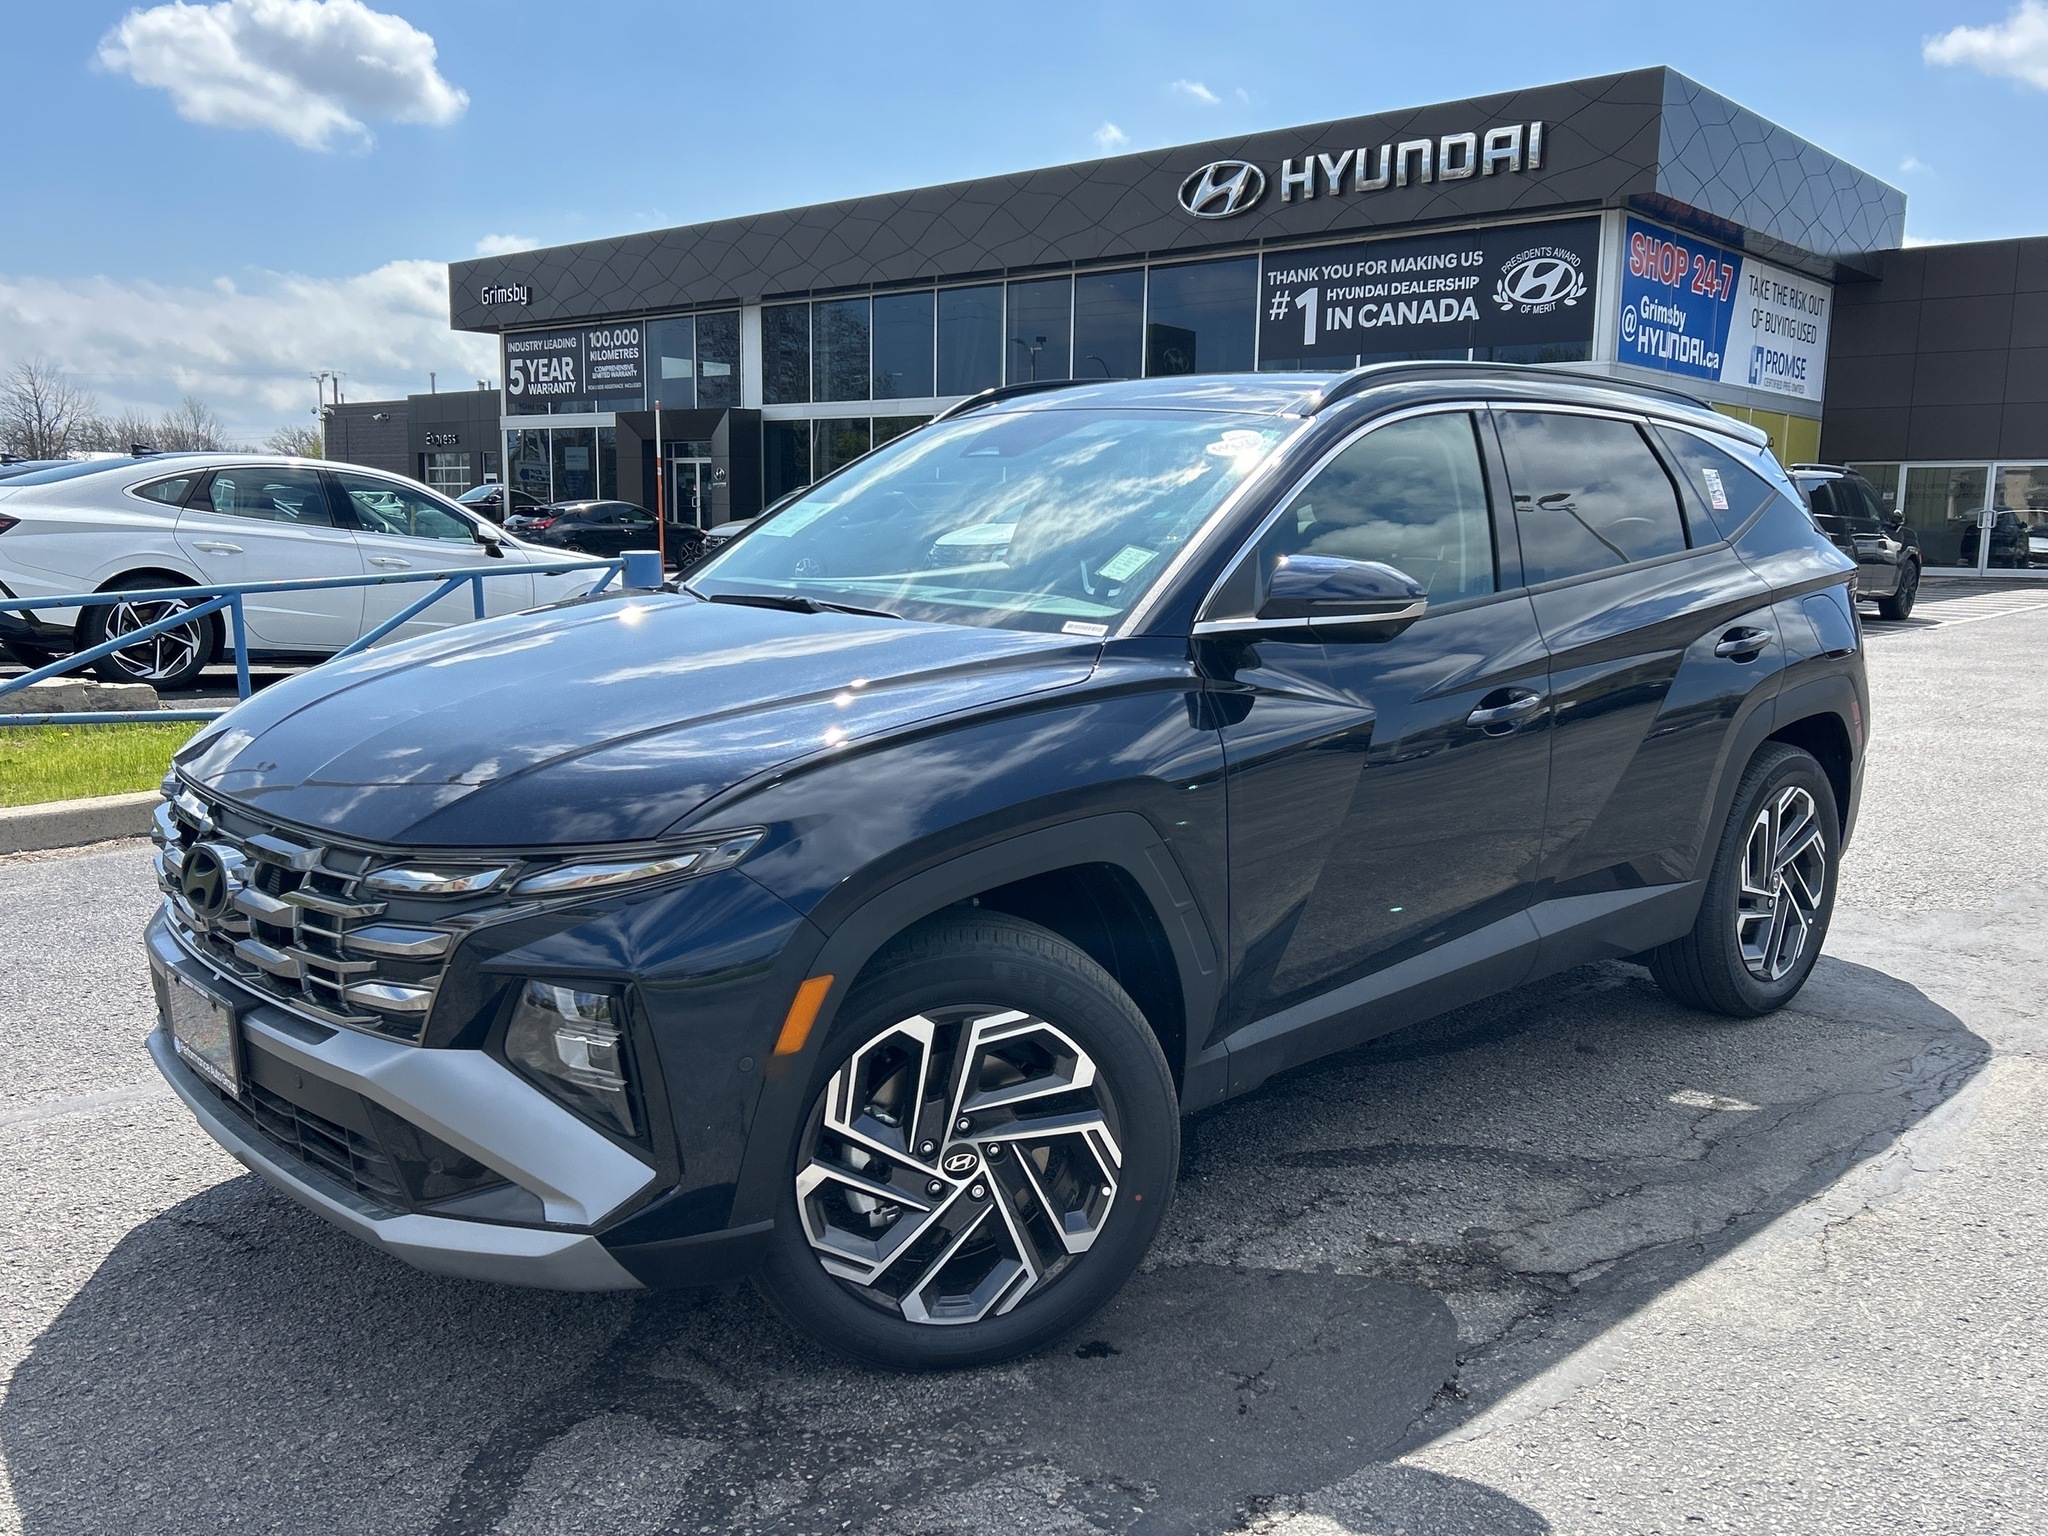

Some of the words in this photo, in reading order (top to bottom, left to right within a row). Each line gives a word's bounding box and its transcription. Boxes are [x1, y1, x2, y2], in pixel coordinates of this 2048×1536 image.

[1281, 121, 1543, 202] HYUNDAI
[1268, 266, 1319, 285] THANK
[1322, 263, 1353, 280] YOU
[1356, 259, 1387, 276] FOR
[1391, 253, 1457, 273] MAKING
[1461, 250, 1484, 267] US
[1553, 247, 1581, 267] AWARD
[1629, 231, 1689, 288] SHOP
[1691, 254, 1734, 302] 24-7
[481, 283, 527, 305] Grimsby
[1326, 283, 1388, 301] HYUNDAI
[1391, 276, 1480, 295] DEALERSHIP
[1749, 274, 1771, 300] TAKE
[1772, 282, 1789, 306] THE
[1789, 288, 1808, 312] RISK
[1809, 295, 1825, 317] OUT
[1326, 306, 1353, 331] IN
[1358, 296, 1480, 328] CANADA
[1520, 304, 1531, 314] OF
[1532, 301, 1556, 314] MERIT
[1640, 295, 1686, 333] Grimsby
[589, 328, 639, 349] 100,000
[1751, 308, 1764, 329] OF
[1764, 312, 1796, 339] BUYING
[1796, 321, 1817, 345] USED
[507, 340, 543, 353] INDUSTRY
[544, 337, 577, 350] LEADING
[590, 348, 639, 361] KILOMETRES
[1637, 324, 1719, 369] HYUNDAI.ca
[508, 358, 525, 395] 5
[526, 357, 575, 382] YEAR
[611, 370, 637, 378] WARRANTY
[1764, 349, 1807, 380] PROMISE
[528, 381, 577, 395] WARRANTY
